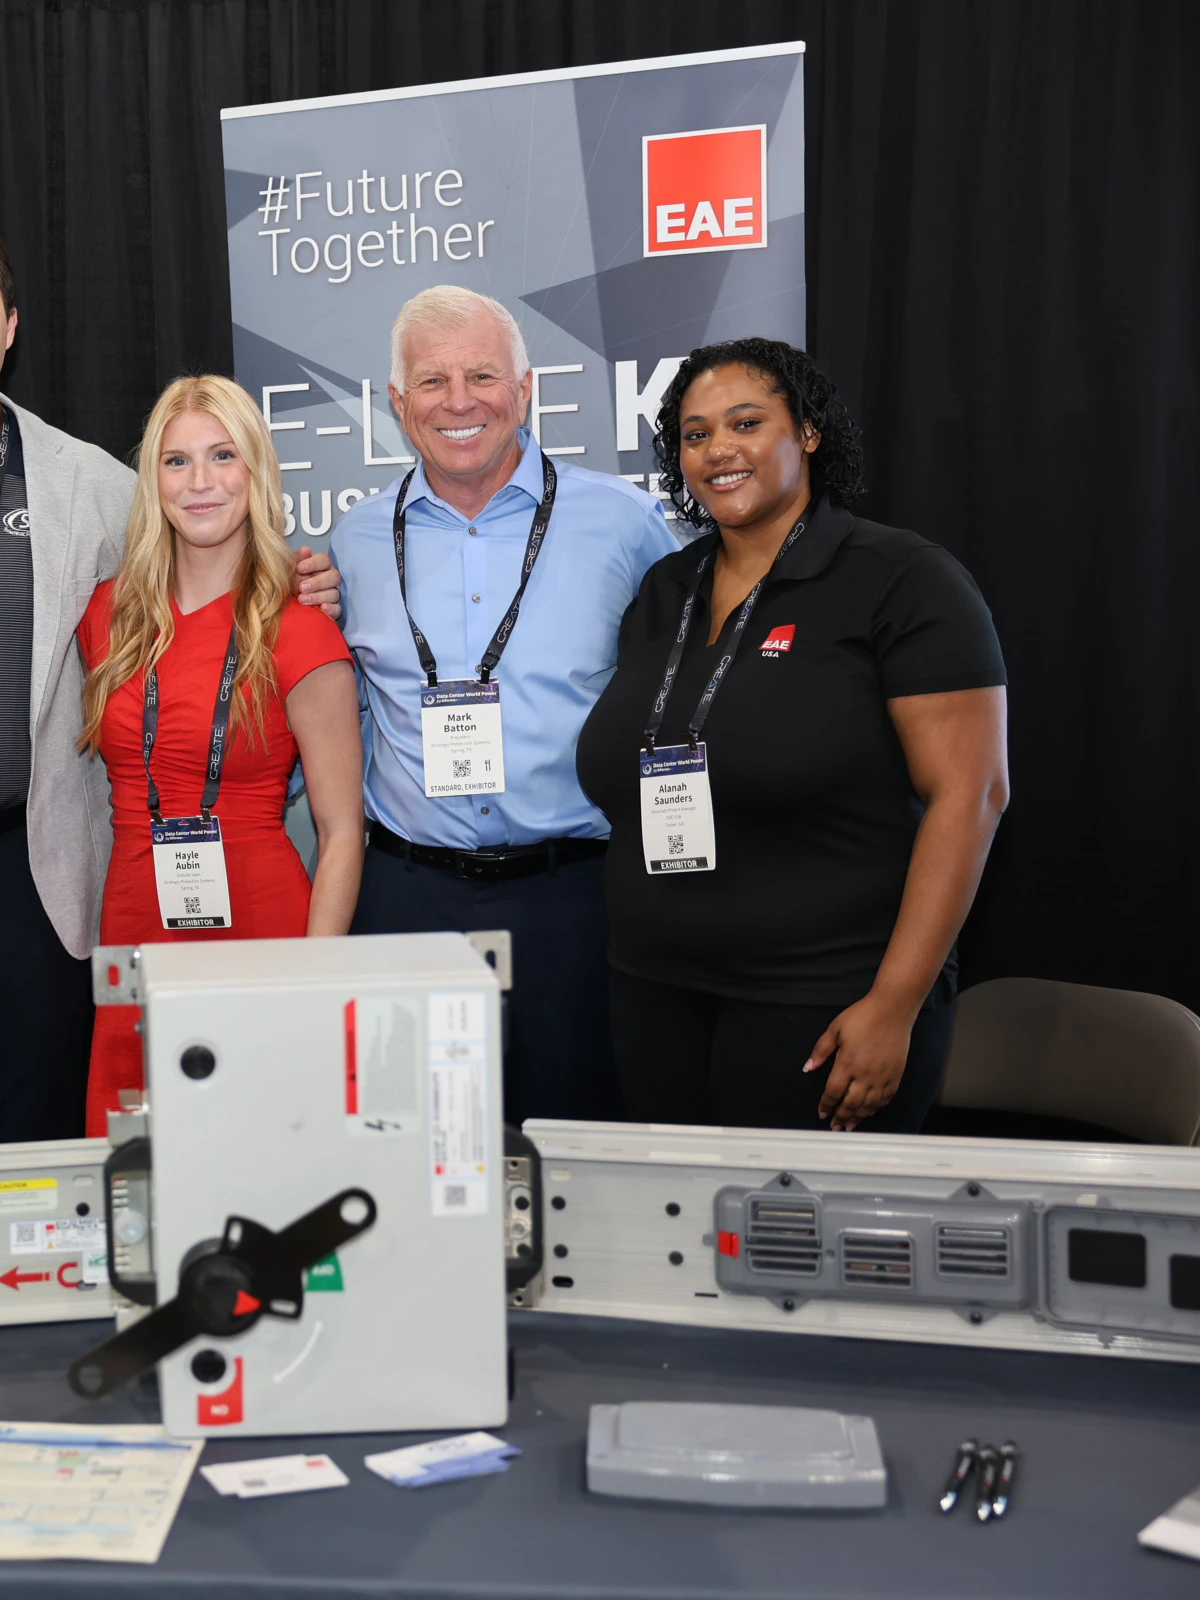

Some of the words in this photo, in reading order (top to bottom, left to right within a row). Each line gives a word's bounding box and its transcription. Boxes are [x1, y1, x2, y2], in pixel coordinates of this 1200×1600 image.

[257, 168, 463, 224] #Future
[655, 198, 754, 244] EAE
[257, 212, 495, 284] Together
[615, 356, 690, 452] K
[761, 639, 791, 650] EAE
[761, 650, 779, 658] USA
[447, 712, 472, 722] Mark
[444, 724, 477, 733] Batton
[430, 784, 464, 793] STANDARD,
[465, 782, 497, 790] EXHIBITOR
[658, 782, 687, 793] Alanah
[654, 794, 693, 806] Saunders
[175, 850, 199, 861] Hayle
[175, 860, 200, 870] Aubin
[660, 859, 698, 870] EXHIBITOR
[177, 918, 214, 927] EXHIBITOR
